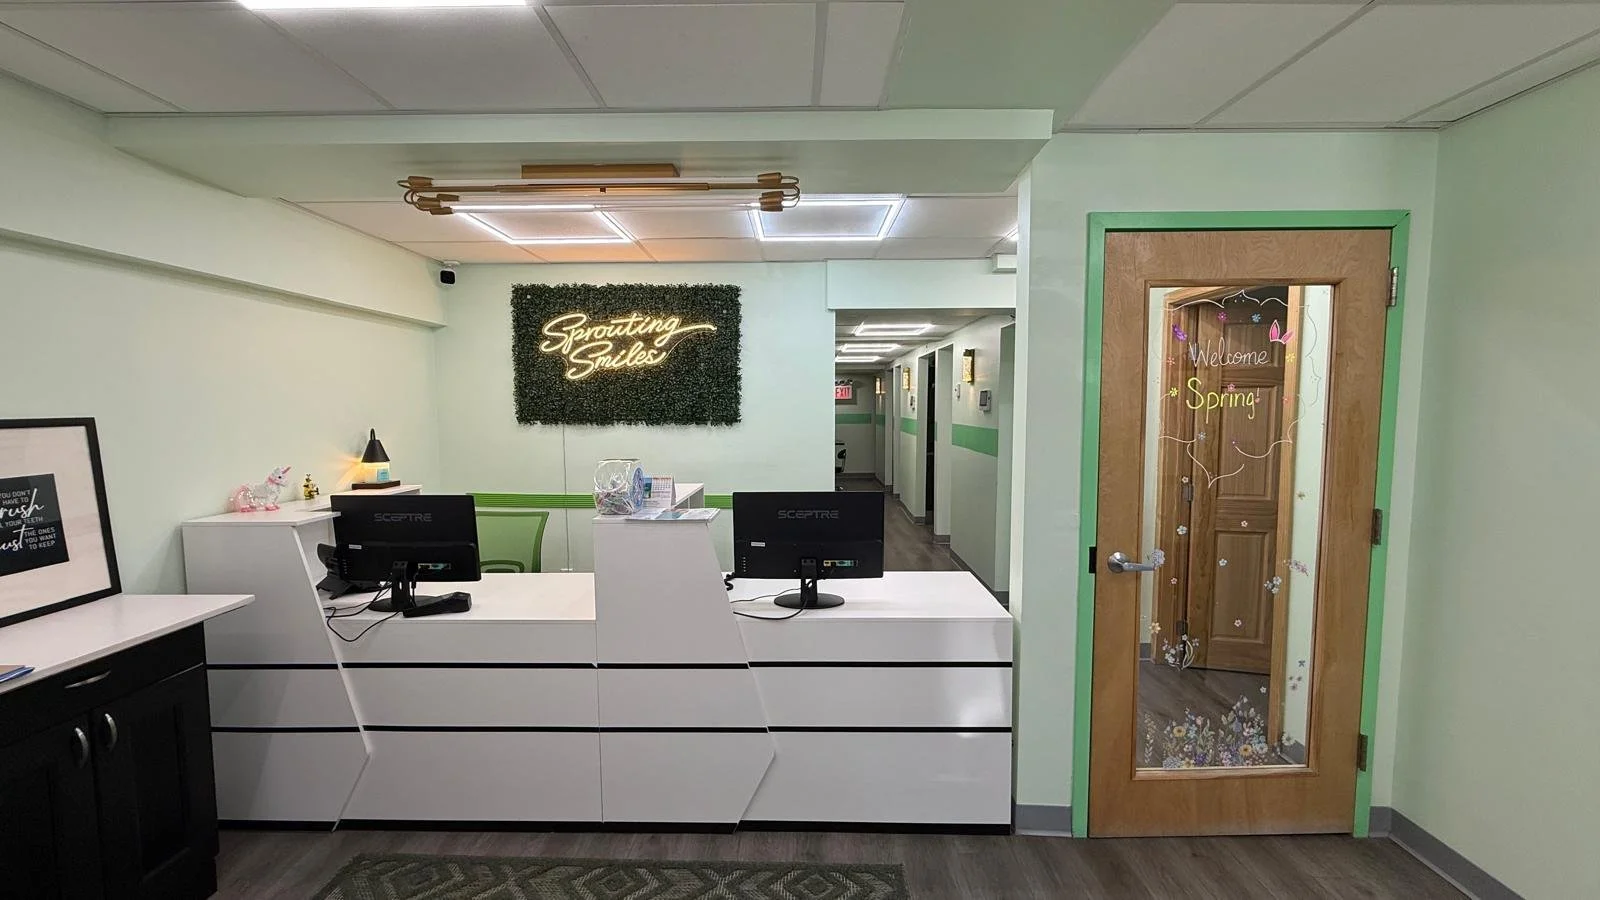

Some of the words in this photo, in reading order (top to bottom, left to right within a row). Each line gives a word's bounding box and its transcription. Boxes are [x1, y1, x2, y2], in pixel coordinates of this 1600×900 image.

[541, 313, 717, 354] Sprouting
[1188, 336, 1269, 368] Welcome
[566, 341, 666, 380] Smiles
[835, 387, 850, 398] EXIT
[374, 512, 432, 522] SCEPTRE
[777, 510, 839, 519] SCEPTRE
[5, 519, 22, 527] YOUR
[24, 516, 43, 524] TEETH
[24, 530, 37, 538] THE
[38, 527, 56, 535] ONES
[39, 533, 56, 541] WANT
[39, 540, 56, 548] KEEP
